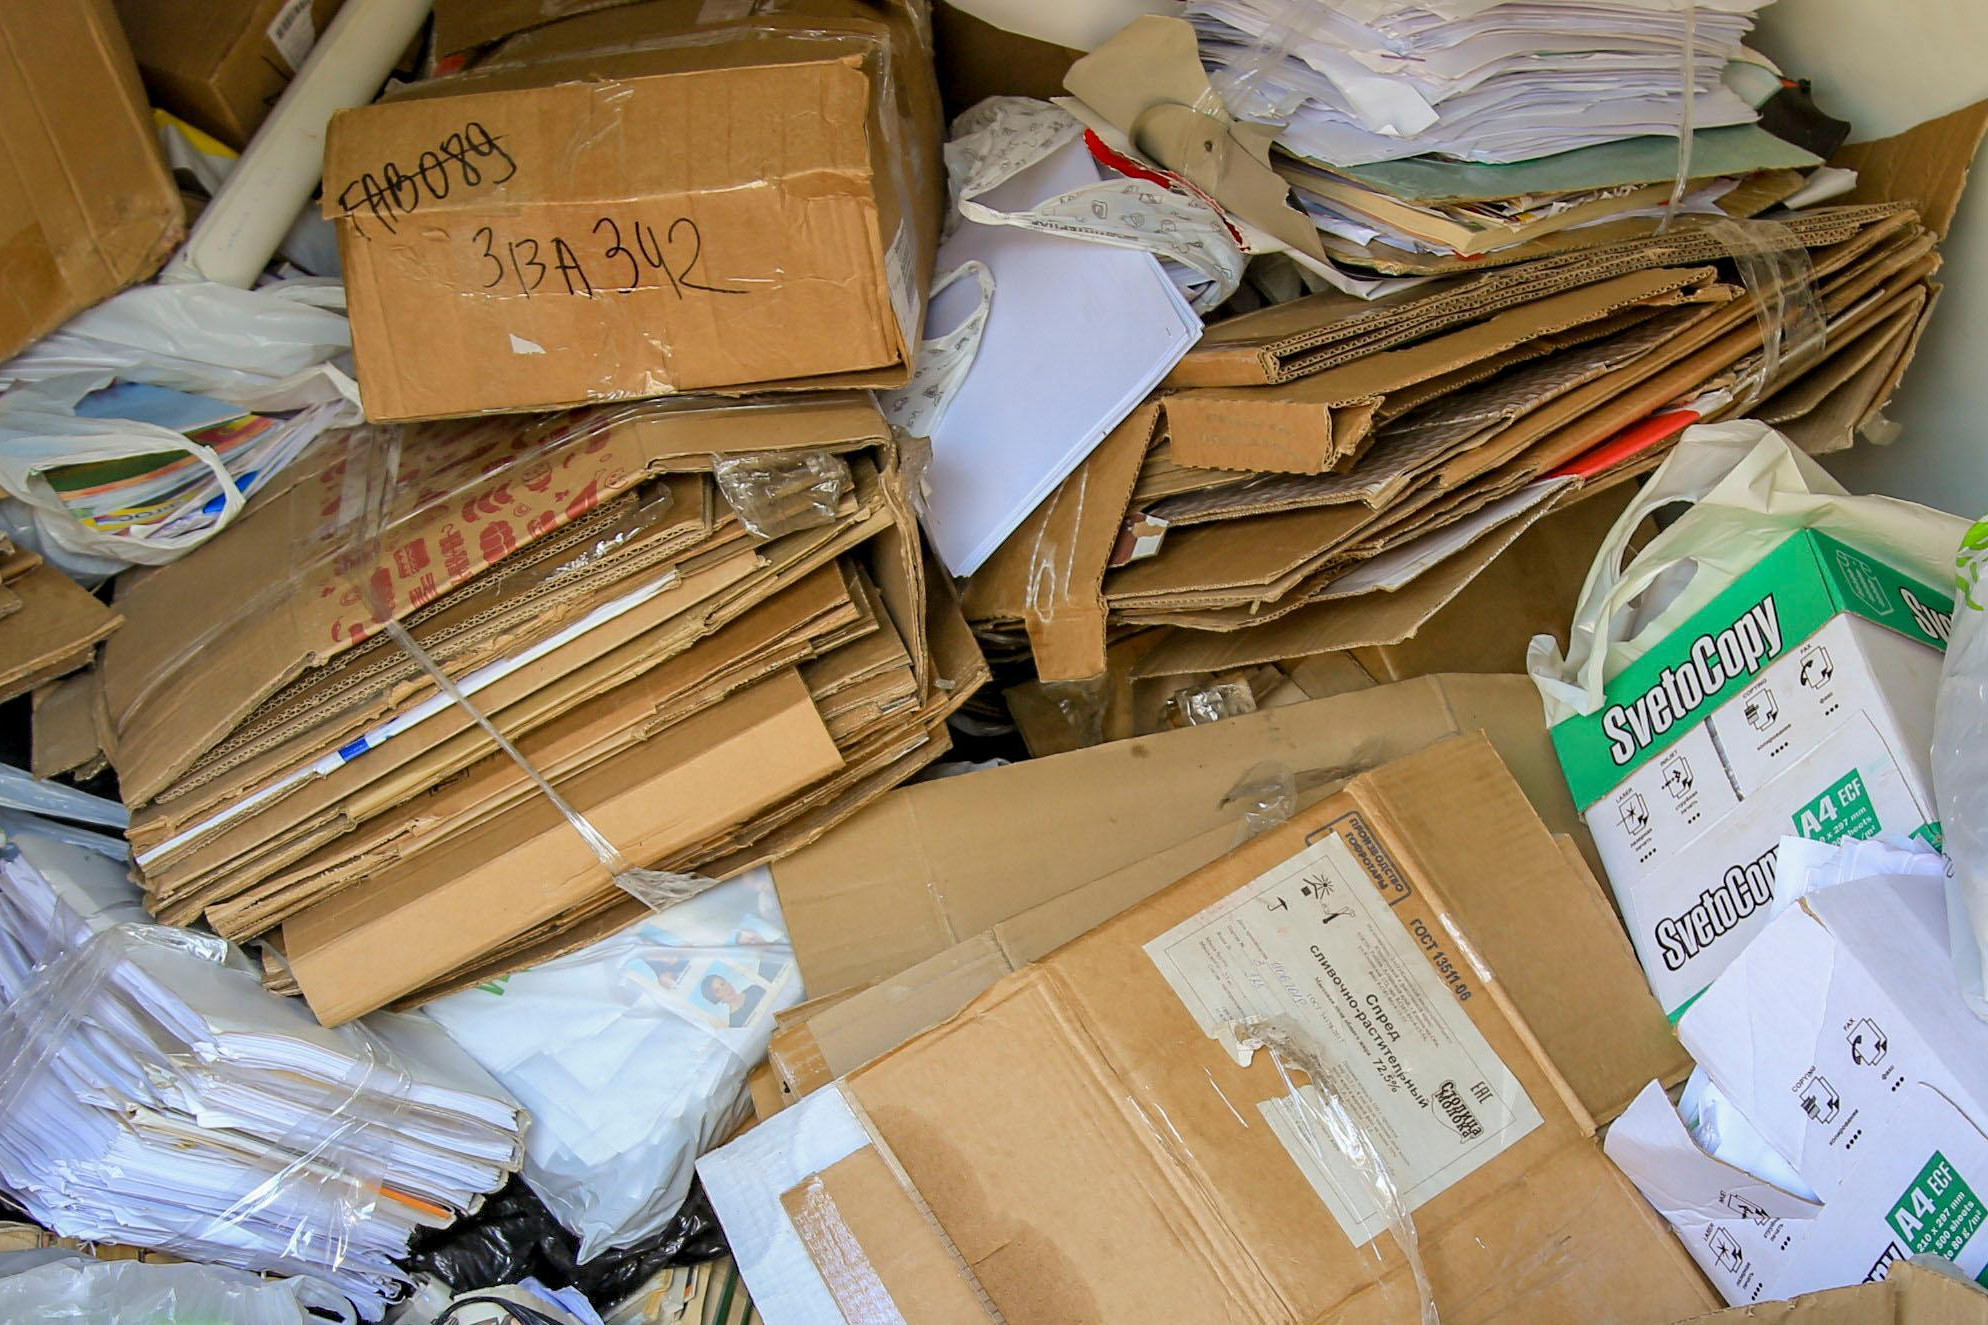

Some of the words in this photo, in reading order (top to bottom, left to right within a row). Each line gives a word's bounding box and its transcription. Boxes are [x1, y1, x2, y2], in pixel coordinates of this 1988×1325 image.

[1799, 643, 1811, 654] FAX
[1602, 594, 1782, 765] SvetoCopy
[1742, 677, 1767, 698] COPYING
[1615, 787, 1633, 802] LASER
[1801, 794, 1838, 839] A4
[1836, 777, 1861, 806] ECF
[1832, 817, 1849, 833] 297
[1850, 806, 1866, 820] mm
[1847, 816, 1873, 836] heets
[1344, 831, 1388, 890] ГОФРОТАРЫ
[1348, 817, 1404, 894] ПРОИЗВОДСТВО
[1655, 844, 1779, 970] SvetoCop
[1408, 917, 1437, 952] ГОСТ
[1431, 950, 1472, 1002] 13511-06
[1363, 992, 1403, 1042] Спред
[1842, 1017, 1855, 1031] FAX
[1371, 1057, 1400, 1093] 72,5%
[1896, 1186, 1936, 1242] A4
[1926, 1161, 1953, 1196] ECF
[1916, 1233, 1933, 1252] 210
[1934, 1207, 1951, 1227] 297
[1949, 1190, 1965, 1210] mm
[1935, 1230, 1951, 1249] 500
[1949, 1200, 1975, 1232] sheets
[1702, 1221, 1715, 1241] LASER
[1950, 1235, 1963, 1250] 80
